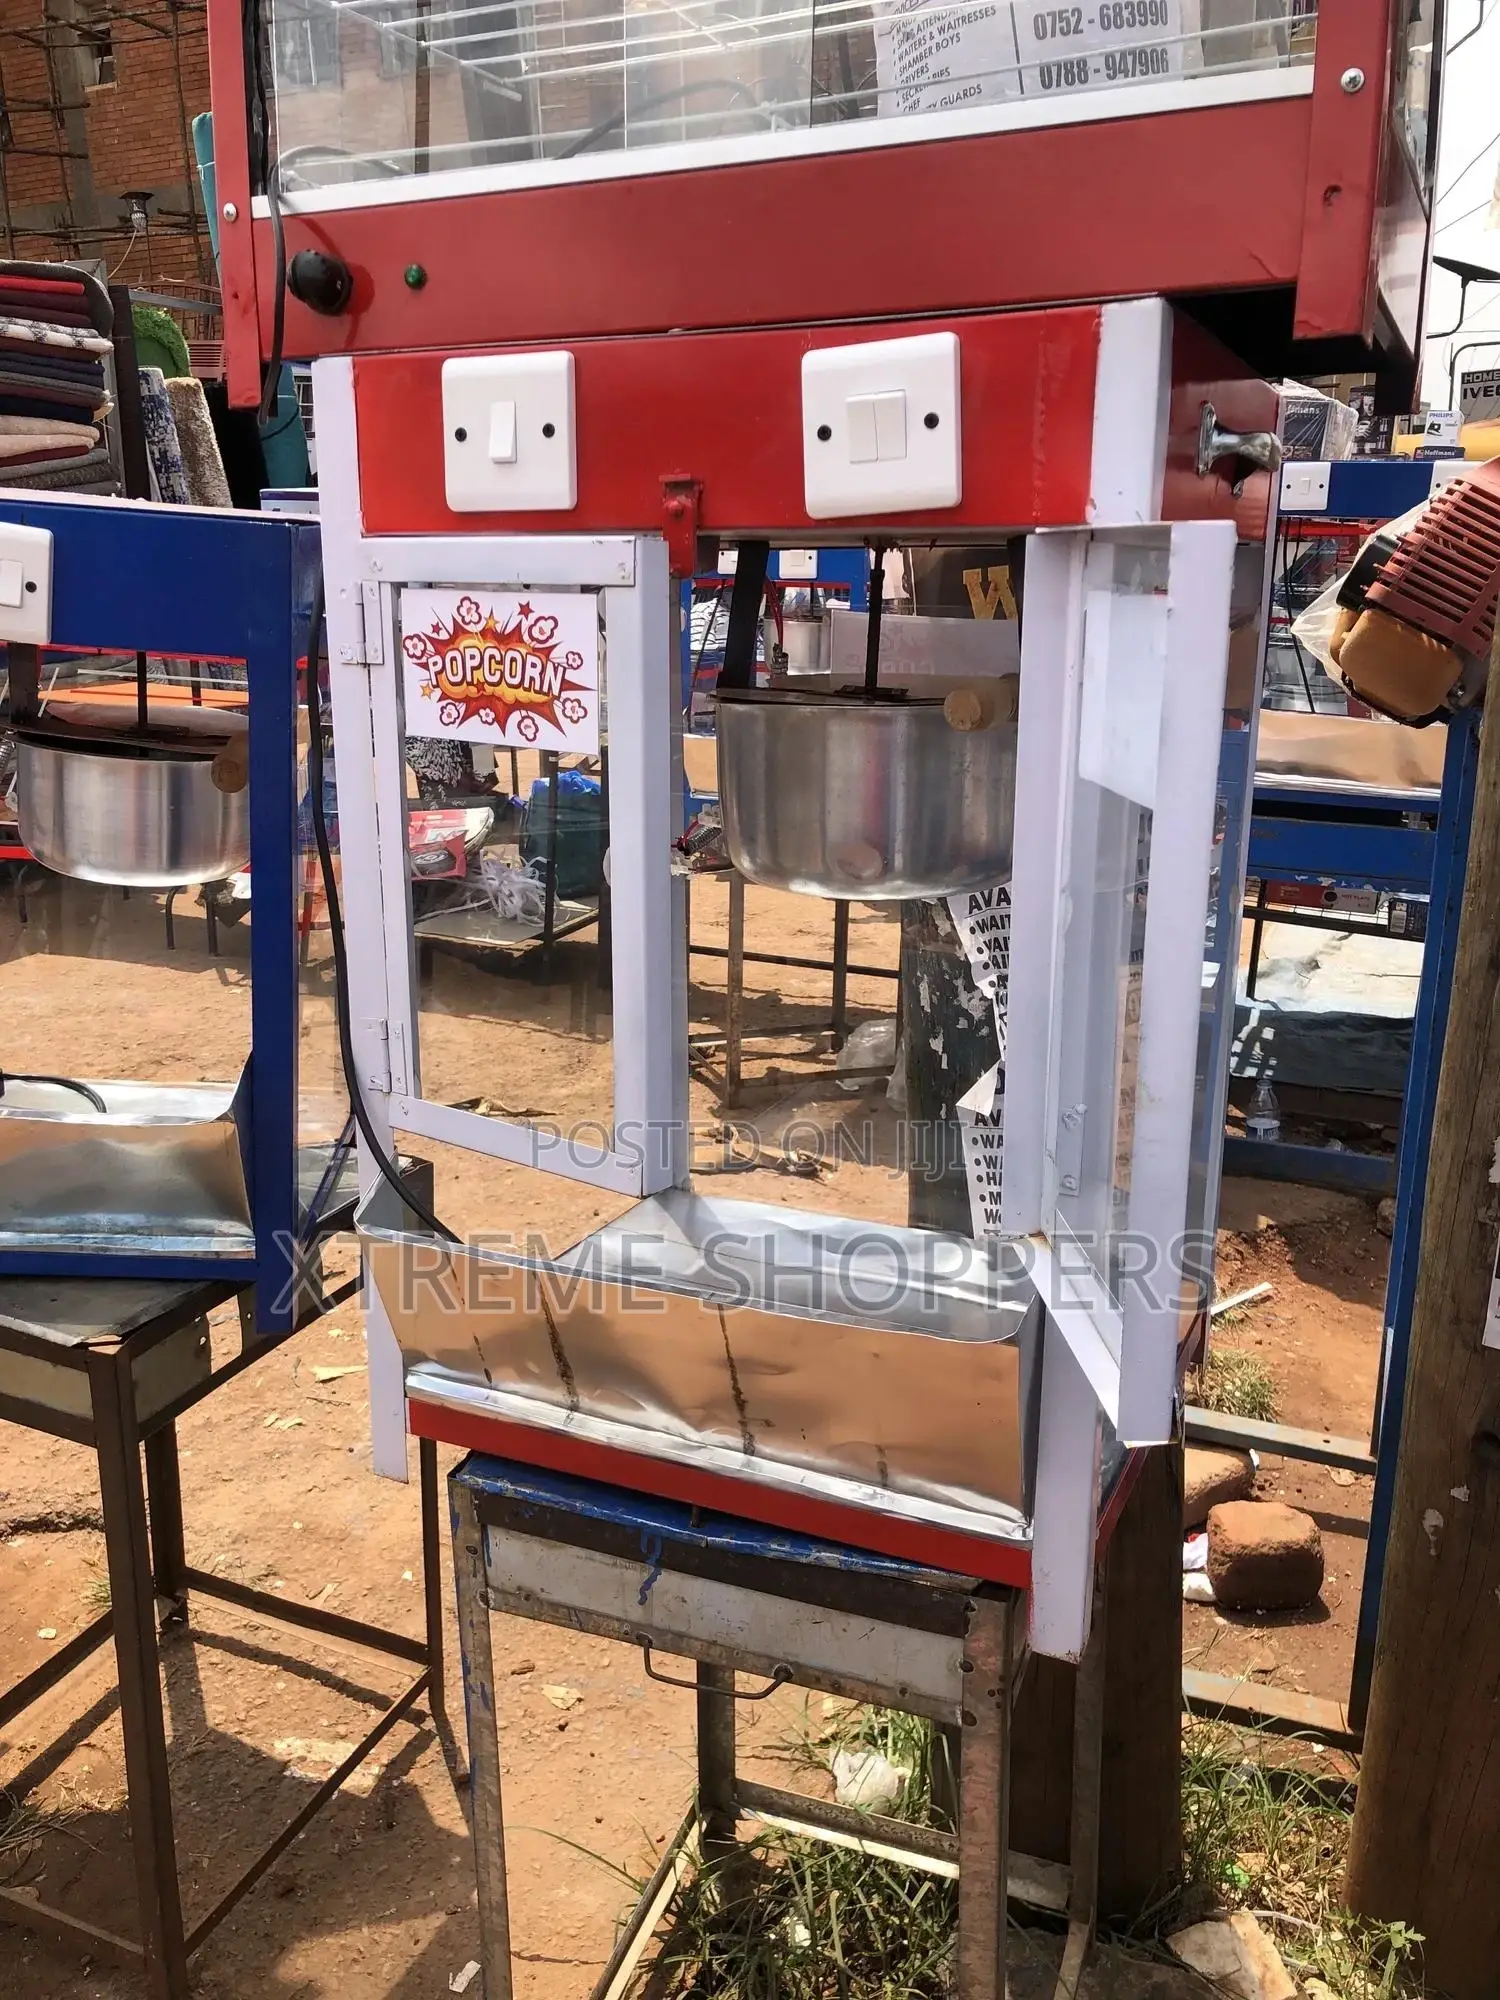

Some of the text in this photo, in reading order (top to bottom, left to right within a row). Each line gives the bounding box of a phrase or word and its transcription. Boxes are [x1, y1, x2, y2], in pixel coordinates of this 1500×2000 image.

[898, 35, 927, 63] WAITERS
[929, 31, 935, 41] &
[937, 5, 997, 36] WAITRESSES
[1034, 8, 1083, 40] 0752
[1100, 0, 1168, 31] 683990
[936, 32, 961, 53] BOYS
[1039, 58, 1089, 90] 0788
[1104, 48, 1169, 80] 947906
[940, 84, 983, 107] GUARDS
[427, 646, 567, 700] POPCORN
[983, 1155, 1003, 1170] W
